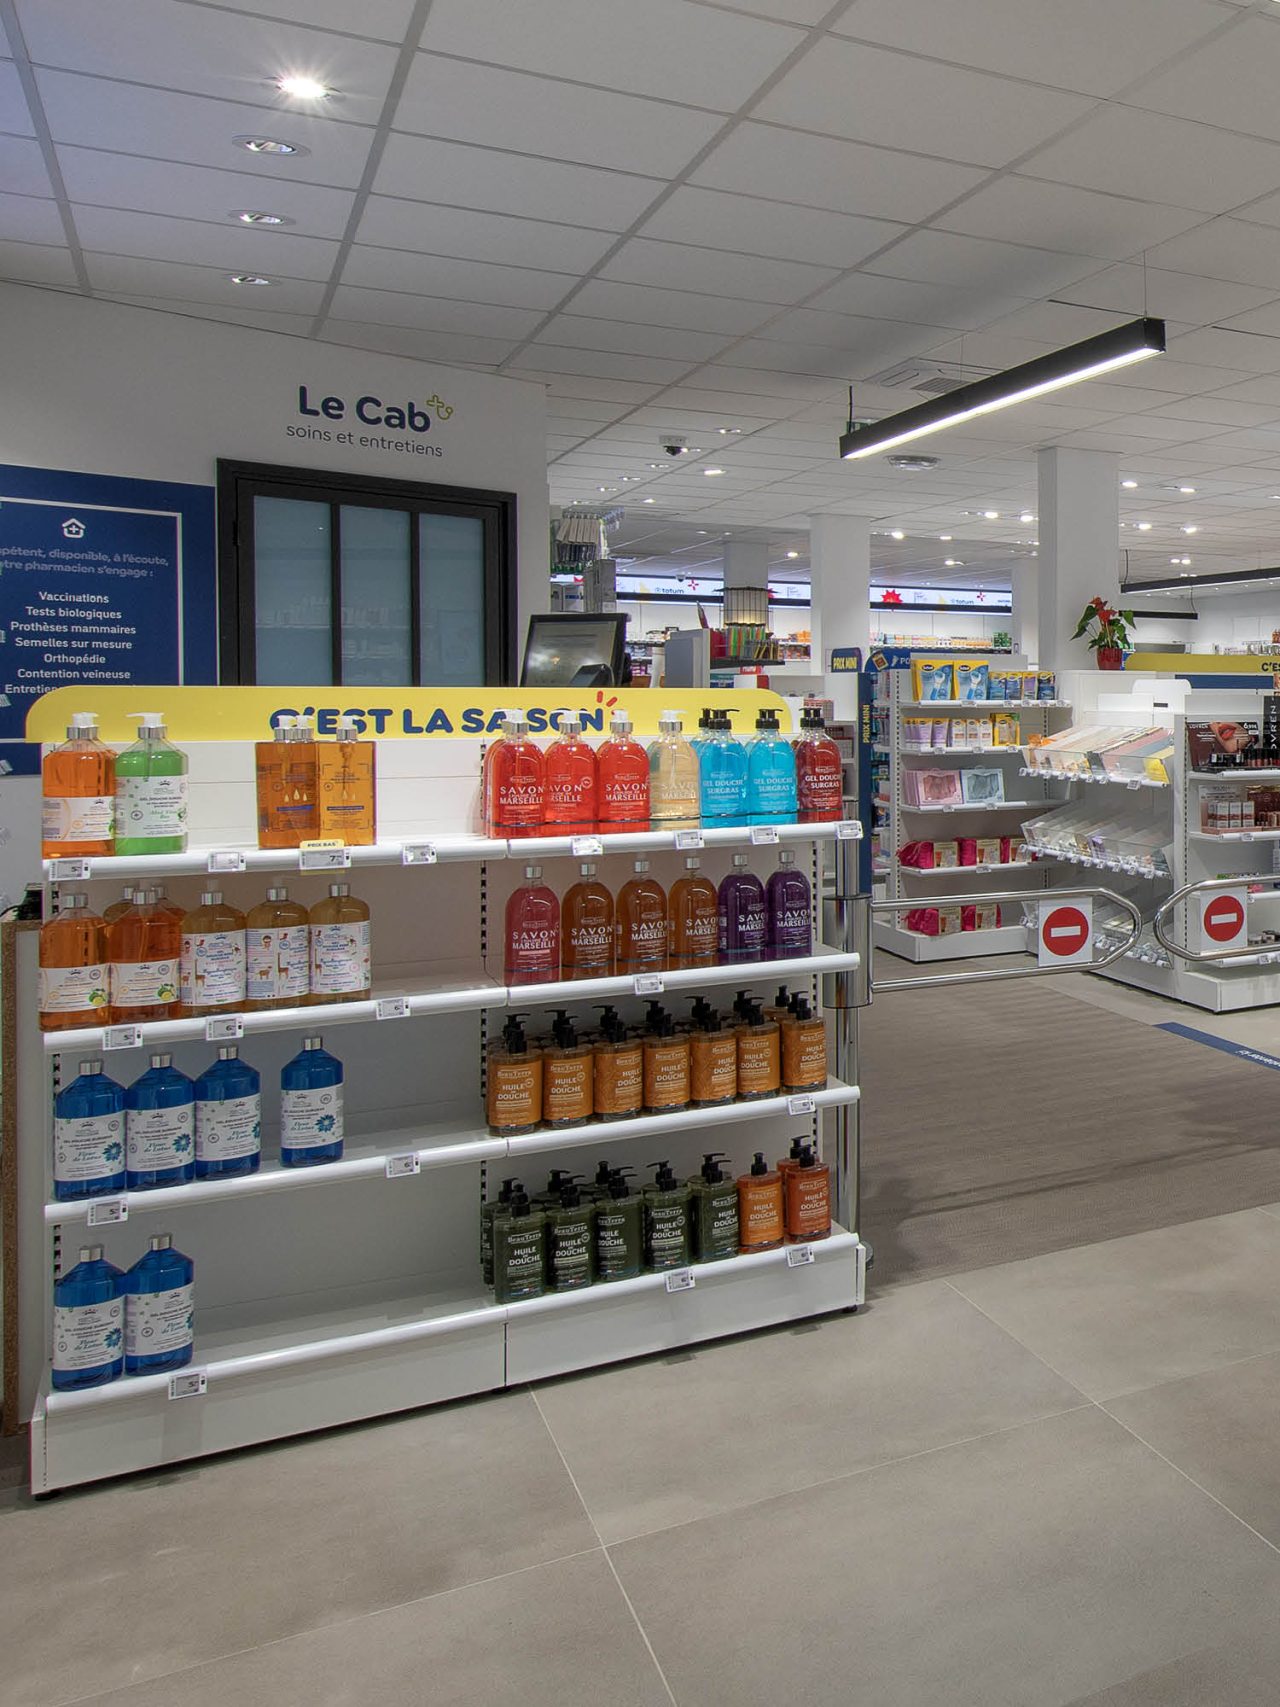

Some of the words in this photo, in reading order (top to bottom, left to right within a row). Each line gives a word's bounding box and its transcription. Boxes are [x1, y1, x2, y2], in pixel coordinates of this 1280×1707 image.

[299, 385, 345, 420] Le
[356, 396, 431, 433] Cab
[286, 425, 332, 441] soins
[337, 432, 355, 445] et
[360, 436, 443, 457] entretiens
[49, 549, 111, 563] disponible,
[113, 552, 121, 562] à
[123, 553, 169, 567] l'écoute,
[25, 561, 95, 573] pharmacien
[97, 565, 148, 578] s'engage
[39, 591, 110, 604] Vaccinations
[25, 606, 56, 617] Tests
[58, 608, 122, 620] biologiques
[10, 621, 68, 633] Prothèses
[71, 625, 137, 635] mammaires
[15, 637, 68, 648] Semelles
[71, 640, 89, 648] sur
[91, 641, 133, 650] mesure
[43, 653, 106, 665] Orthopédie
[17, 668, 80, 678] Contention
[82, 669, 132, 679] veineuse
[403, 708, 454, 734] LA
[500, 785, 544, 794] SAVON
[605, 783, 648, 792] SAVON
[811, 781, 839, 789] SURGRAS
[500, 797, 543, 805] MARSEILLE
[605, 792, 647, 800] MARSEILLE
[512, 930, 556, 940] SAVON
[571, 925, 613, 936] SAVON
[512, 941, 555, 950] MARSEILLE
[571, 936, 612, 946] MARSEILLE
[656, 1072, 685, 1081] DOUCHE
[502, 1083, 524, 1091] HUILE
[551, 1086, 582, 1094] DOUCHE
[497, 1092, 530, 1100] DOUCHE
[804, 1193, 822, 1201] HUILE
[801, 1200, 827, 1210] DOUCHE
[750, 1211, 777, 1220] DOUCHE
[652, 1230, 682, 1239] DOUCHE
[560, 1239, 581, 1247] HUILE
[514, 1246, 537, 1256] HUILE
[555, 1247, 586, 1257] DOUCHE
[509, 1255, 541, 1266] DOUCHE
